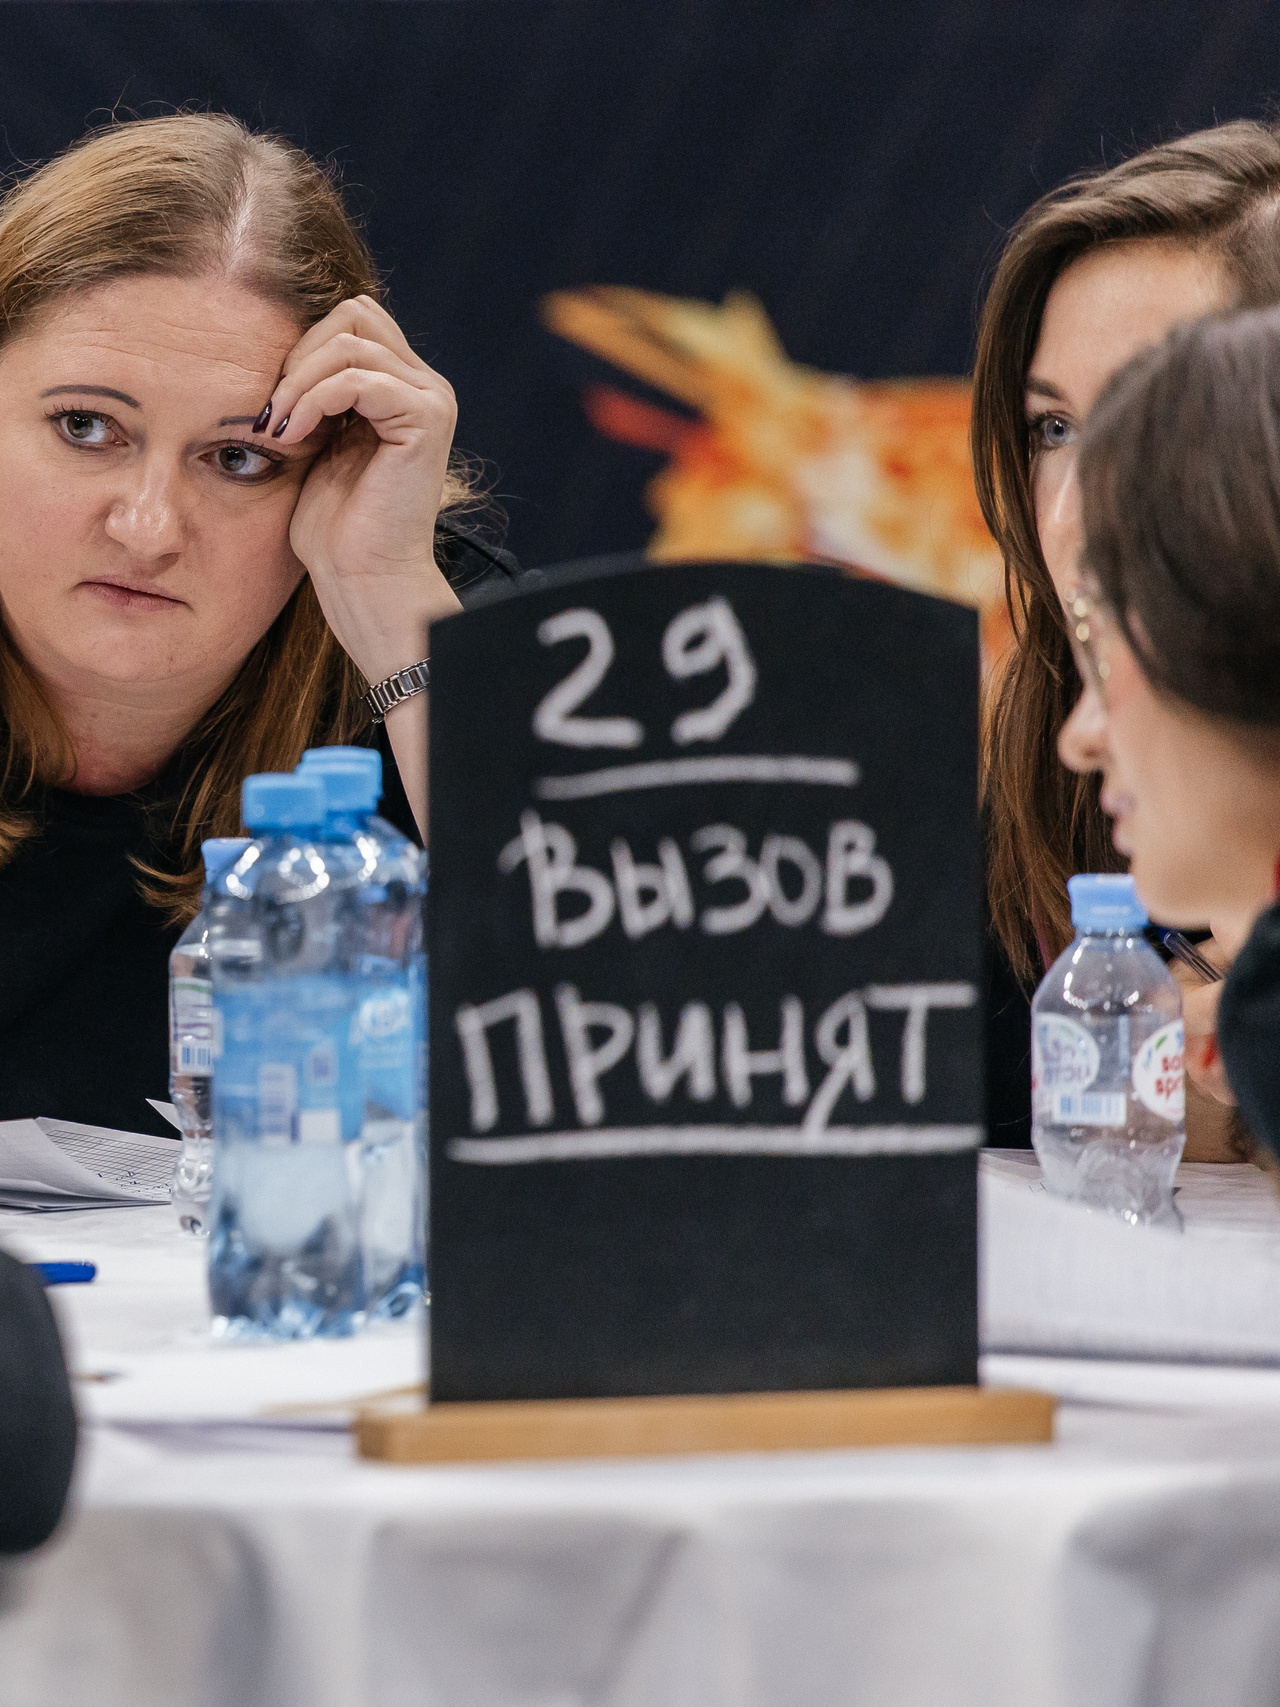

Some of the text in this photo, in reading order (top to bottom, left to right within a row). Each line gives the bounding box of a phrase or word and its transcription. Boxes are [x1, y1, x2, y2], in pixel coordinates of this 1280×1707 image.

[533, 595, 758, 749] 29
[497, 809, 895, 949] ВЫЗОВ
[455, 982, 978, 1138] ПРИНЯТ
